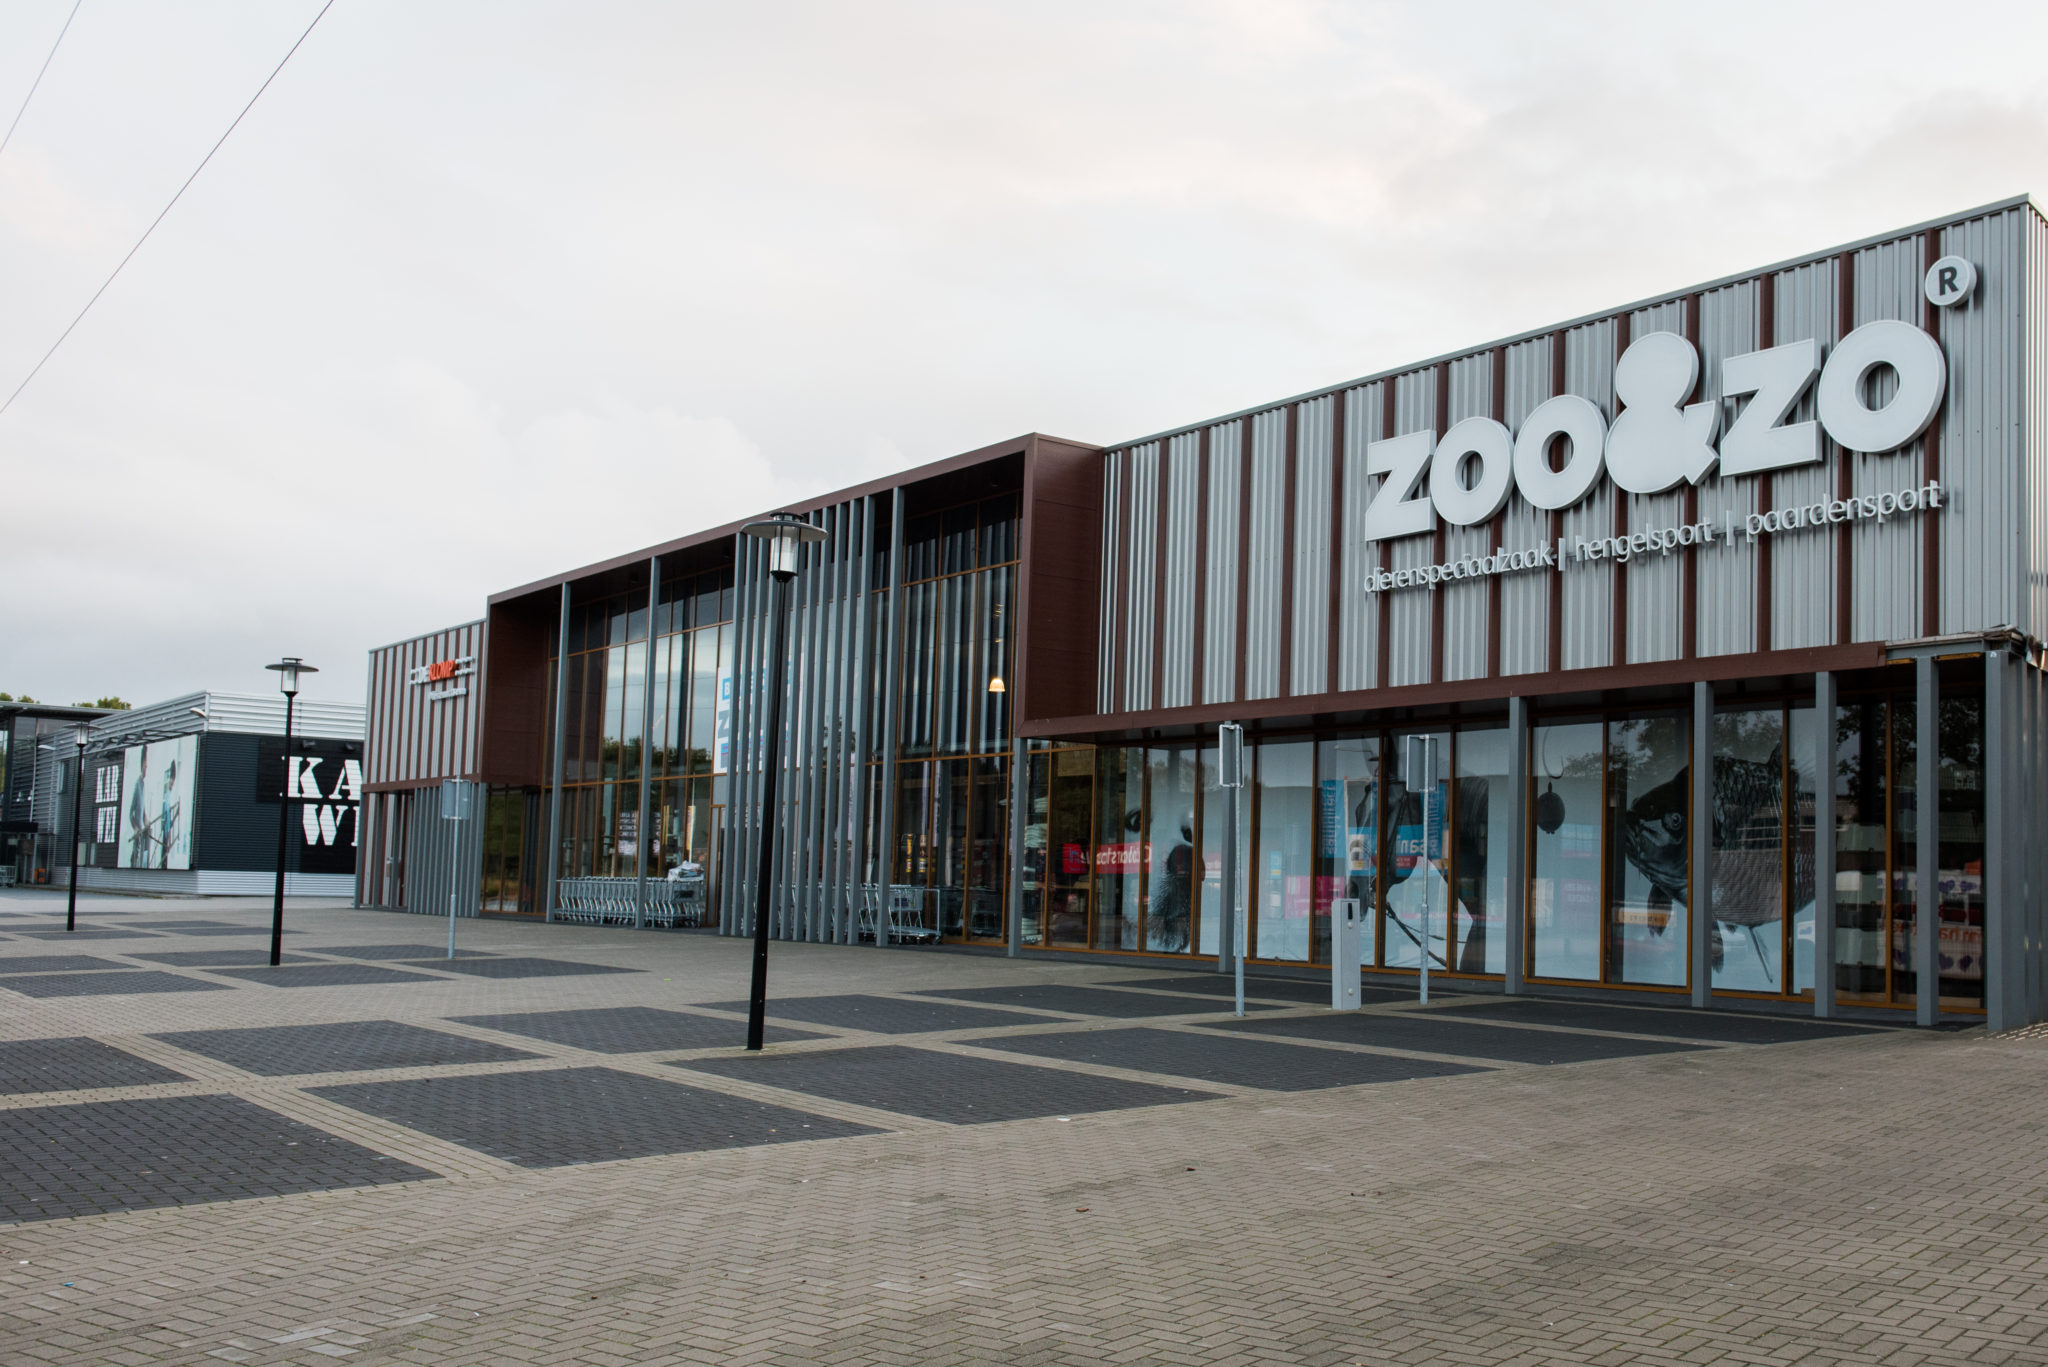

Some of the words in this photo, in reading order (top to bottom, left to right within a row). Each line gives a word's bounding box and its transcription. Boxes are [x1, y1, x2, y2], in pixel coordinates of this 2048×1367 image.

[1363, 539, 1556, 593] dierenspeciaalzaak
[1575, 516, 1715, 563] hengelsport
[1745, 480, 1941, 543] paardensport
[95, 765, 119, 804] KAR
